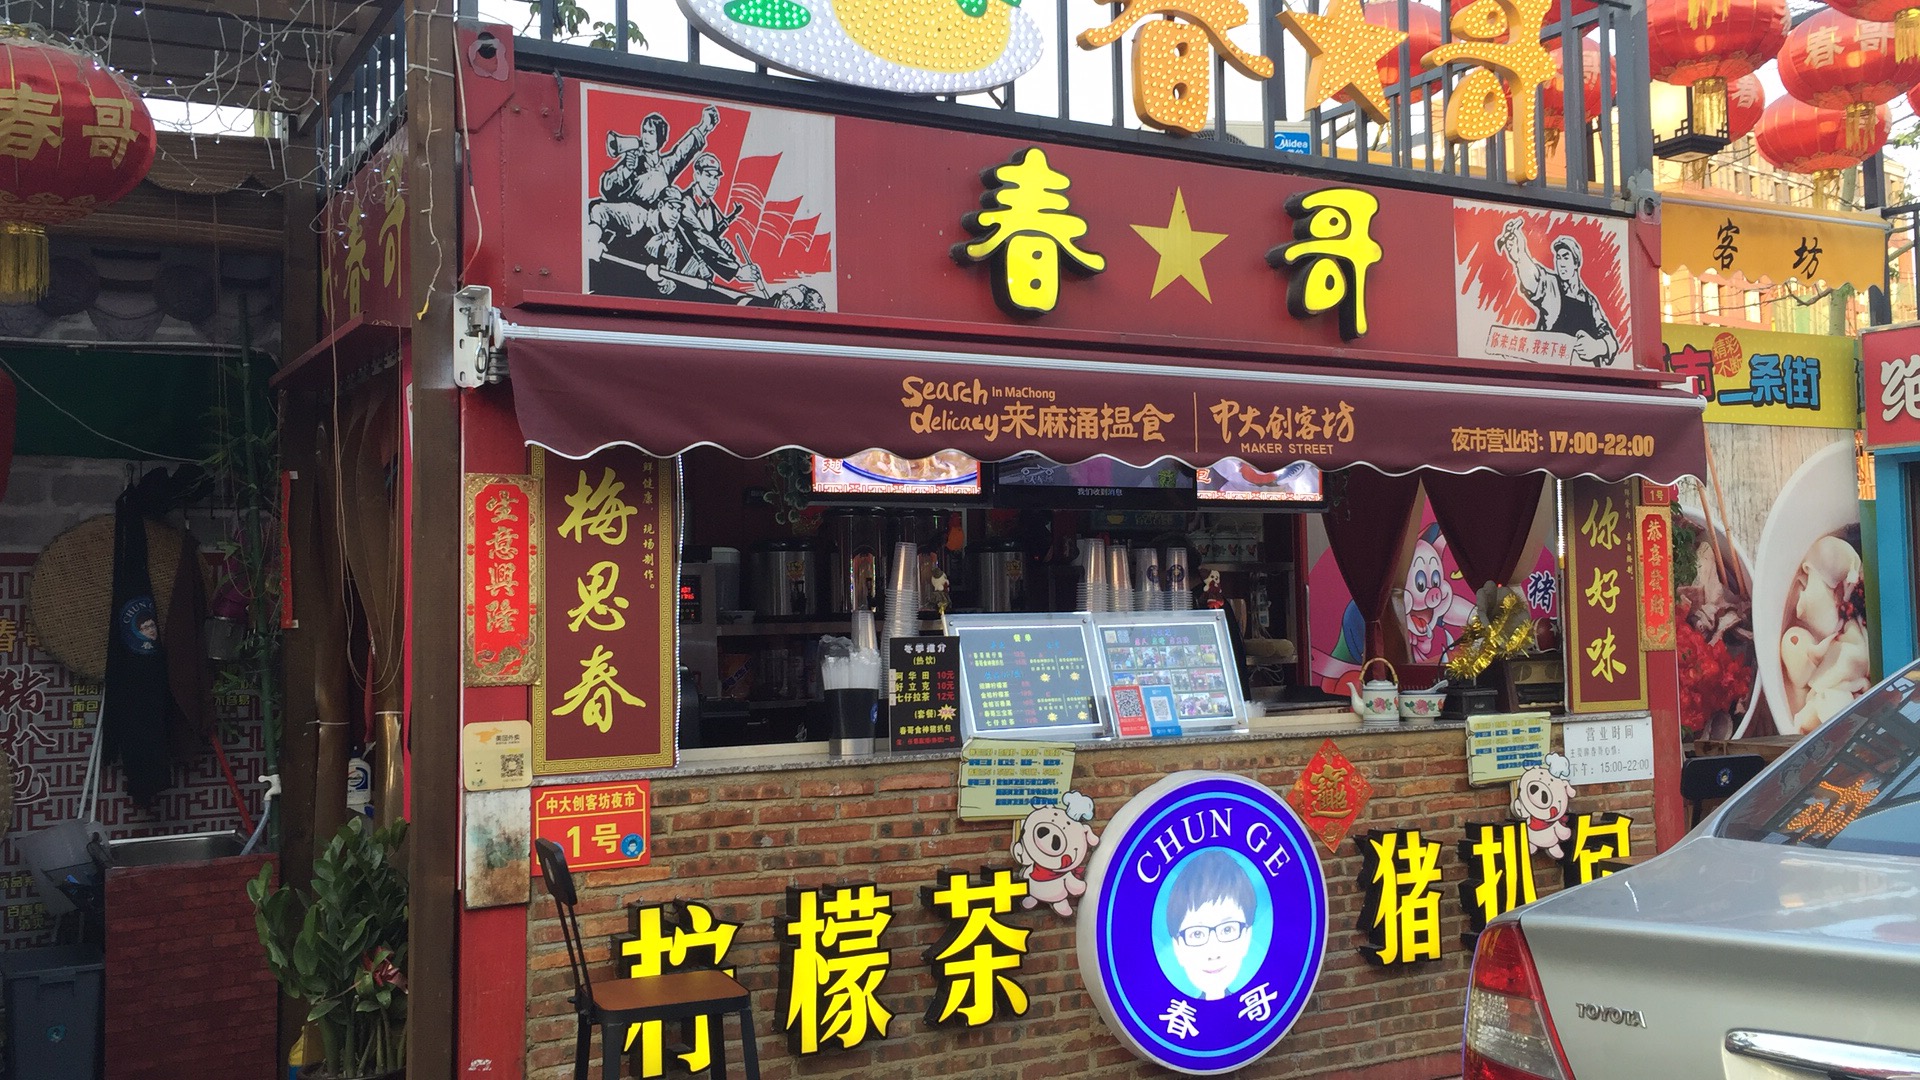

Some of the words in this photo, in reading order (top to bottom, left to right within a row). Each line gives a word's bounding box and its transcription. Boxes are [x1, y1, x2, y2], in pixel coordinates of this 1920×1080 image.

[0, 82, 140, 169] 春哥
[1281, 139, 1308, 148] Midea
[980, 146, 1107, 312] 春
[1280, 187, 1384, 338] 哥
[901, 375, 988, 408] Search
[991, 386, 1003, 398] In
[1005, 386, 1056, 401] MaChong
[1663, 342, 1821, 410] 市一条街
[910, 402, 1000, 440] delicacy
[1001, 402, 1175, 442] 来麻涌揾食
[1209, 398, 1356, 444] 中大创客坊
[1240, 441, 1283, 455] MAKER
[1288, 443, 1335, 456] STREET
[1549, 429, 1656, 459] 17:00-22:00
[1649, 489, 1665, 502] 1号
[551, 466, 647, 734] 梅思春
[1528, 570, 1557, 612] 猪
[1580, 495, 1628, 684] 你好味
[1585, 724, 1635, 742] 营业时间
[1600, 758, 1650, 774] 15:00-22:00
[546, 790, 636, 815] 中大创客坊夜市
[566, 822, 621, 859] 1号
[1135, 807, 1233, 885] CHUN
[1245, 822, 1291, 878] GE
[622, 870, 1030, 1079] 柠檬茶
[1576, 1002, 1647, 1029] TOYOTA
